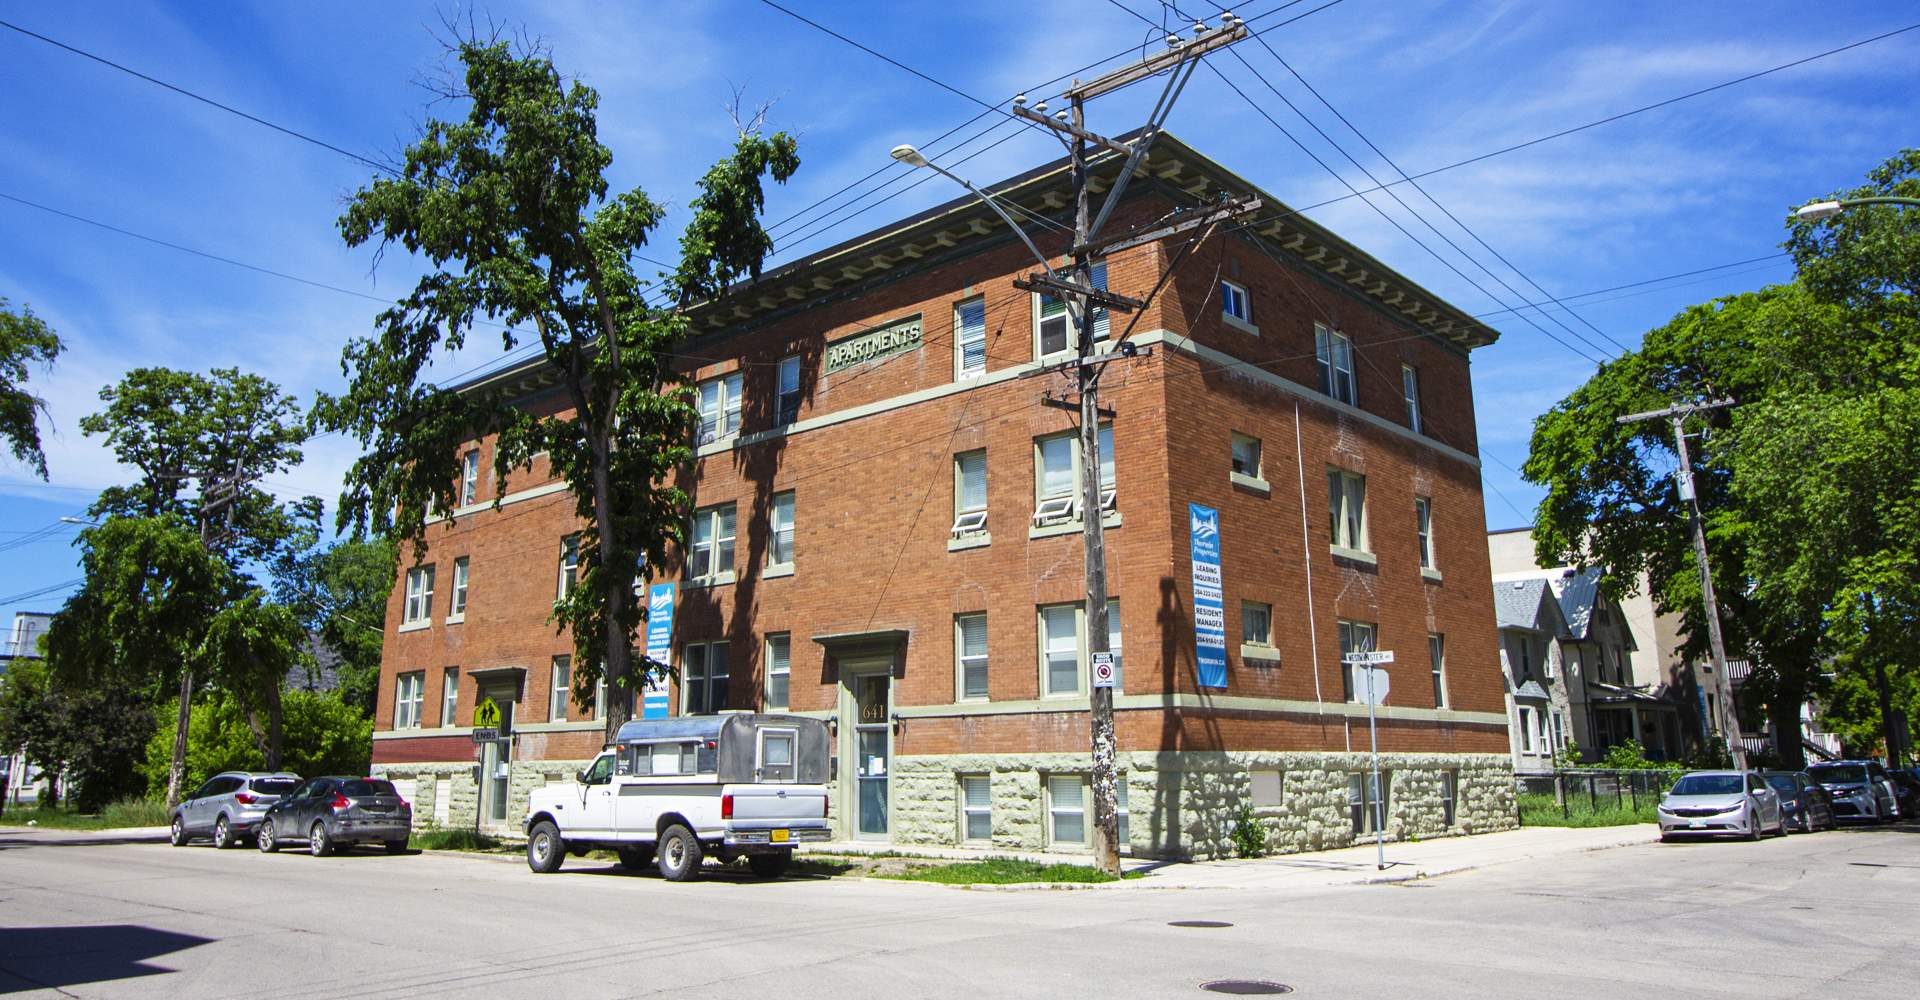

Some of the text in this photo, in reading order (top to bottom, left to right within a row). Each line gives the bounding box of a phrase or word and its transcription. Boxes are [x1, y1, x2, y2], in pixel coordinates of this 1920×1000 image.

[829, 324, 920, 365] APARTMENTS
[1196, 565, 1217, 574] LEASING
[1194, 574, 1219, 584] INQUIRIES
[1195, 607, 1222, 617] RESIDENT
[1196, 618, 1223, 628] MANAGER
[862, 704, 885, 719] 641
[475, 732, 497, 740] ENDS
